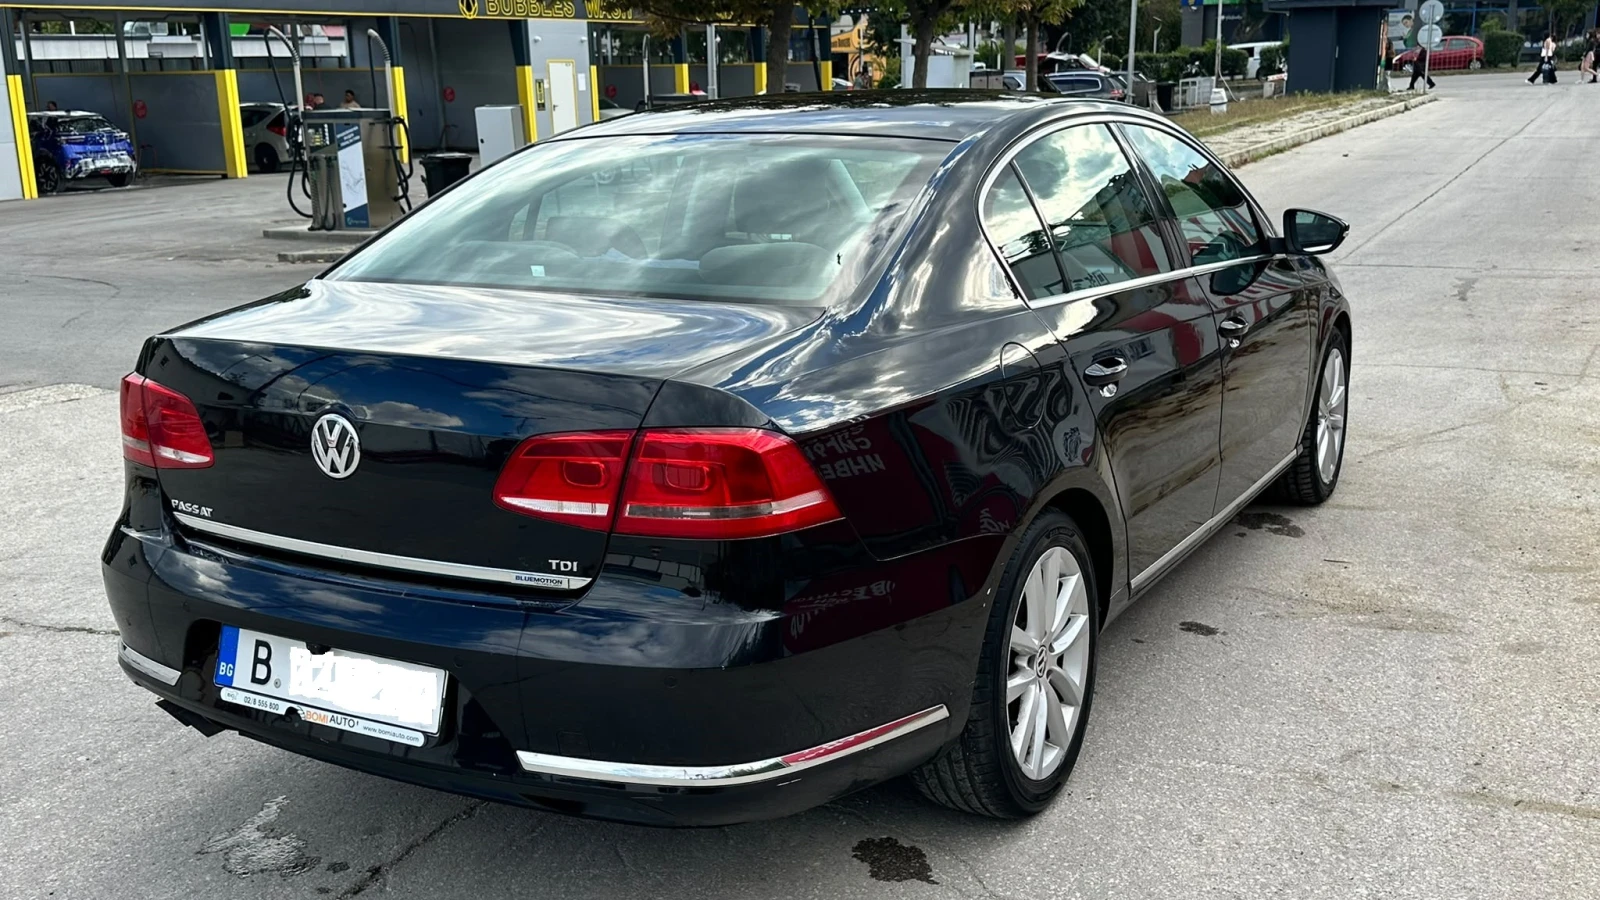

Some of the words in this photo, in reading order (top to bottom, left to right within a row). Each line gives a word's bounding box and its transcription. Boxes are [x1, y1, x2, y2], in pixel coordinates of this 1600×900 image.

[486, 0, 576, 17] BUBBLES
[171, 499, 213, 517] PASSAT
[548, 559, 579, 572] TDI
[515, 575, 563, 585] BLUEMOTION
[219, 662, 234, 677] BG
[250, 639, 272, 686] B
[305, 710, 329, 724] BOMI
[362, 725, 420, 743] www.bomiauto.com
